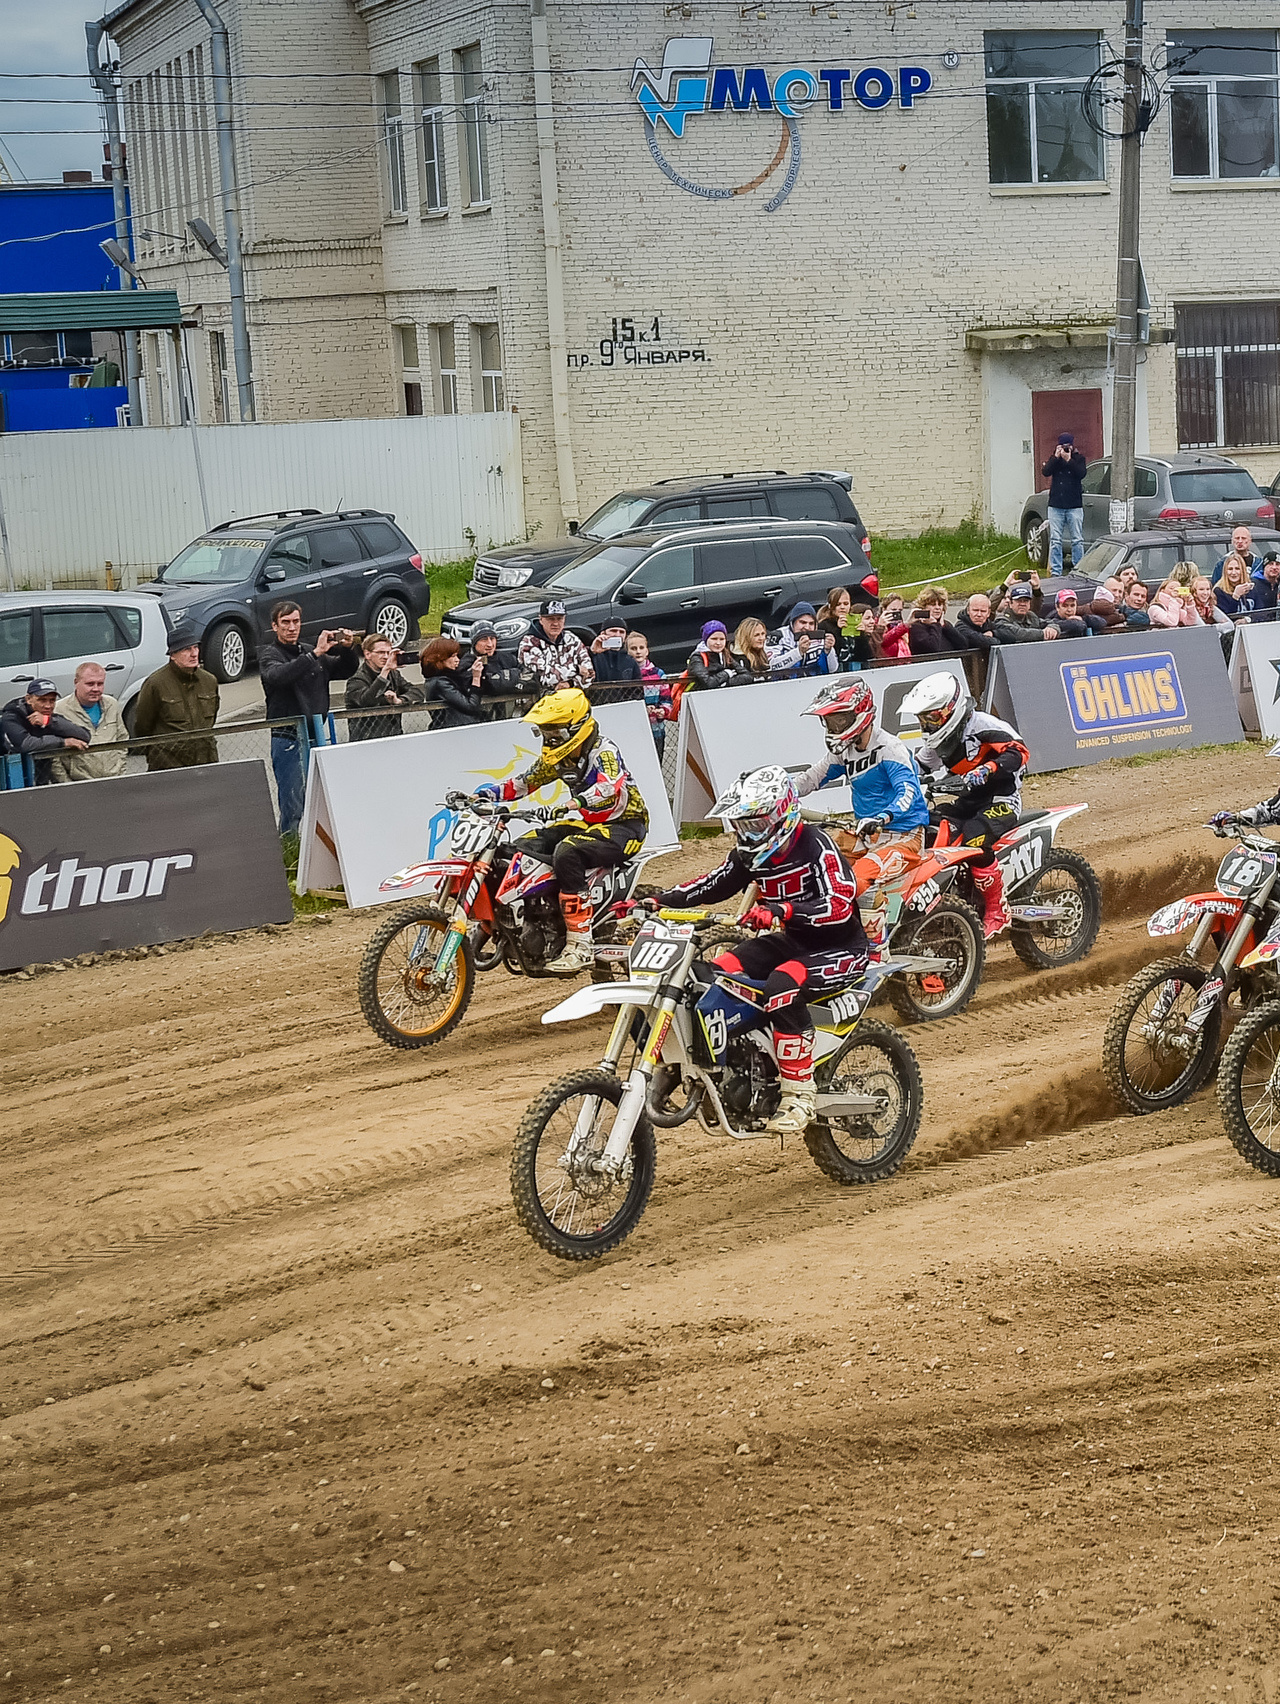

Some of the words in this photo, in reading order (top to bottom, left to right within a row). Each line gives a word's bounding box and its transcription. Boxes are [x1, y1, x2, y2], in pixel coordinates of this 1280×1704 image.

[1069, 666, 1179, 723] ÖHLINS
[1076, 736, 1110, 749] ADVANCED
[1112, 731, 1151, 744] SUSPENSION
[1152, 724, 1193, 738] TECHNOLOGY
[451, 821, 493, 853] 911
[20, 853, 194, 916] thor
[1221, 856, 1263, 887] 18
[911, 877, 941, 912] 354
[631, 941, 679, 970] 118
[827, 993, 860, 1024] 118
